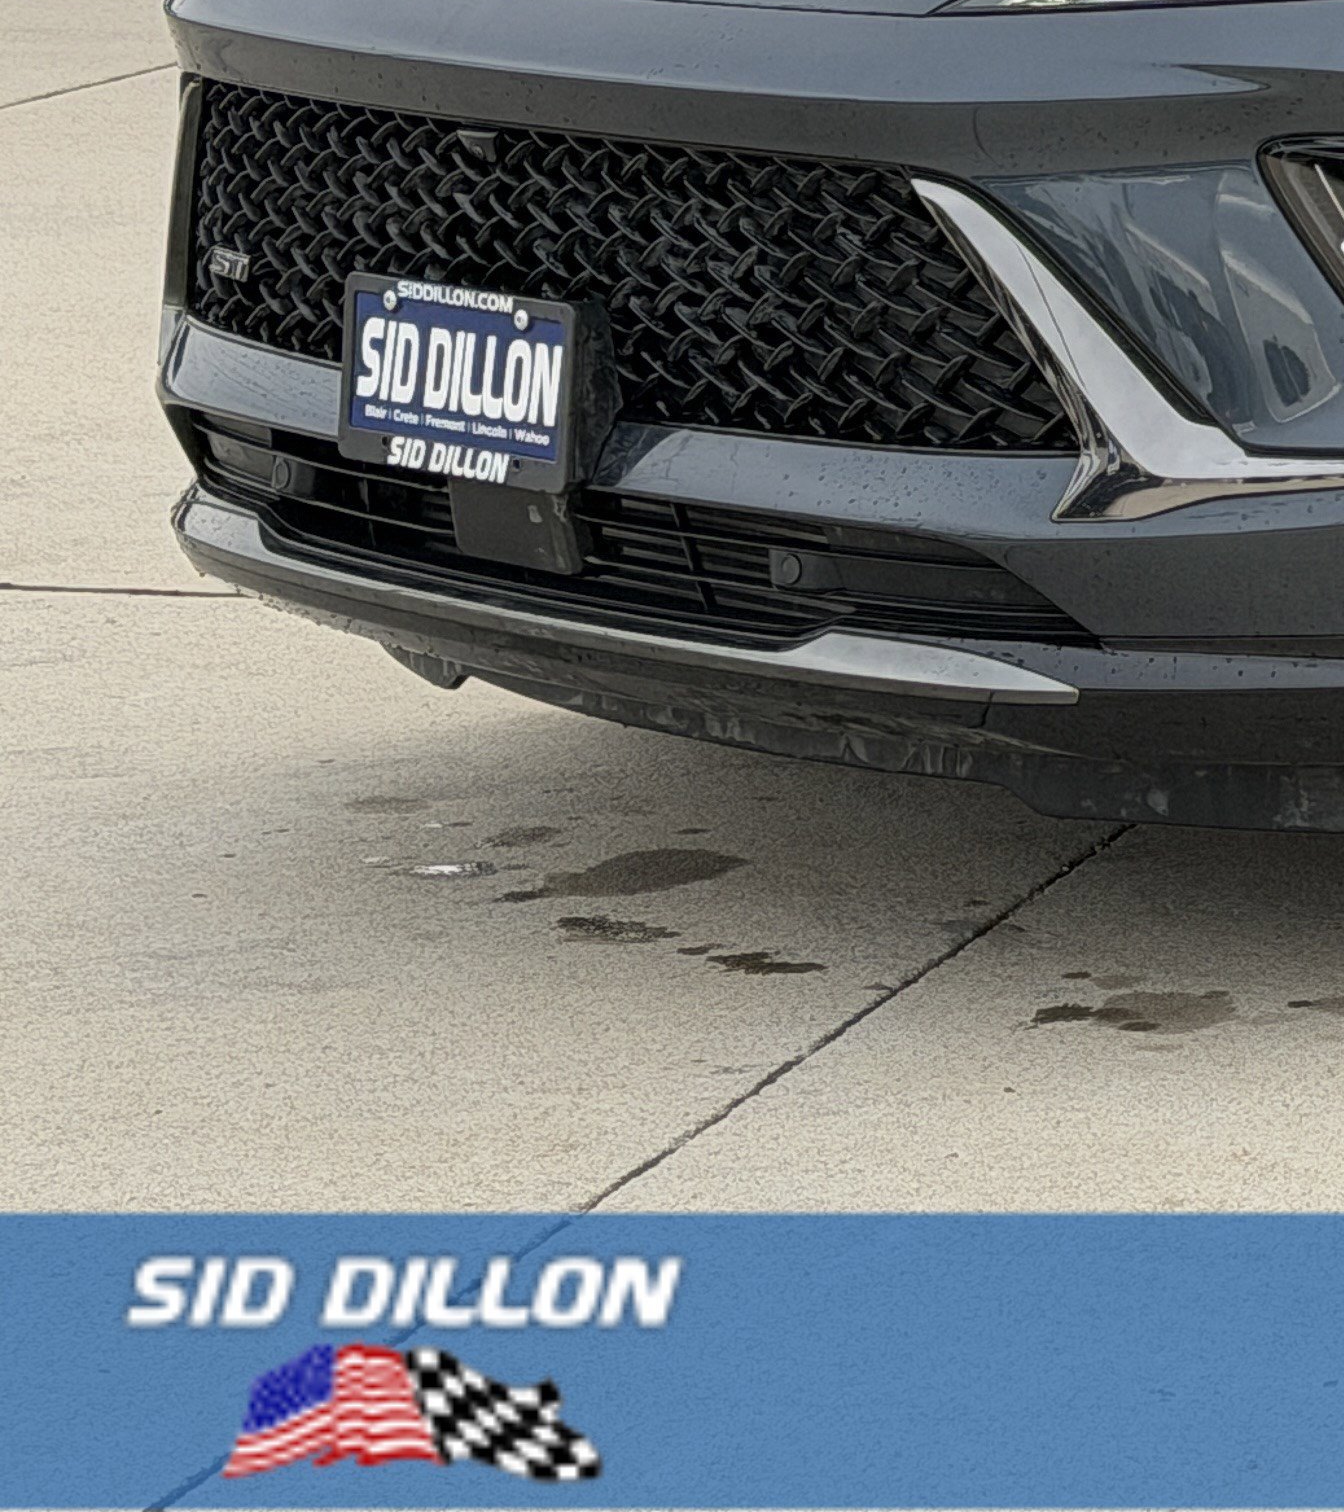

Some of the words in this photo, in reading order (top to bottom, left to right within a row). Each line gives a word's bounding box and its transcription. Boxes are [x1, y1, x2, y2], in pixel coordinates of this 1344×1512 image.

[397, 279, 514, 313] SIDDILLON.COM
[355, 316, 420, 404] SID
[423, 326, 564, 427] DILLON
[393, 409, 420, 426] Crete
[386, 435, 427, 469] SID
[427, 442, 510, 484] DILLON
